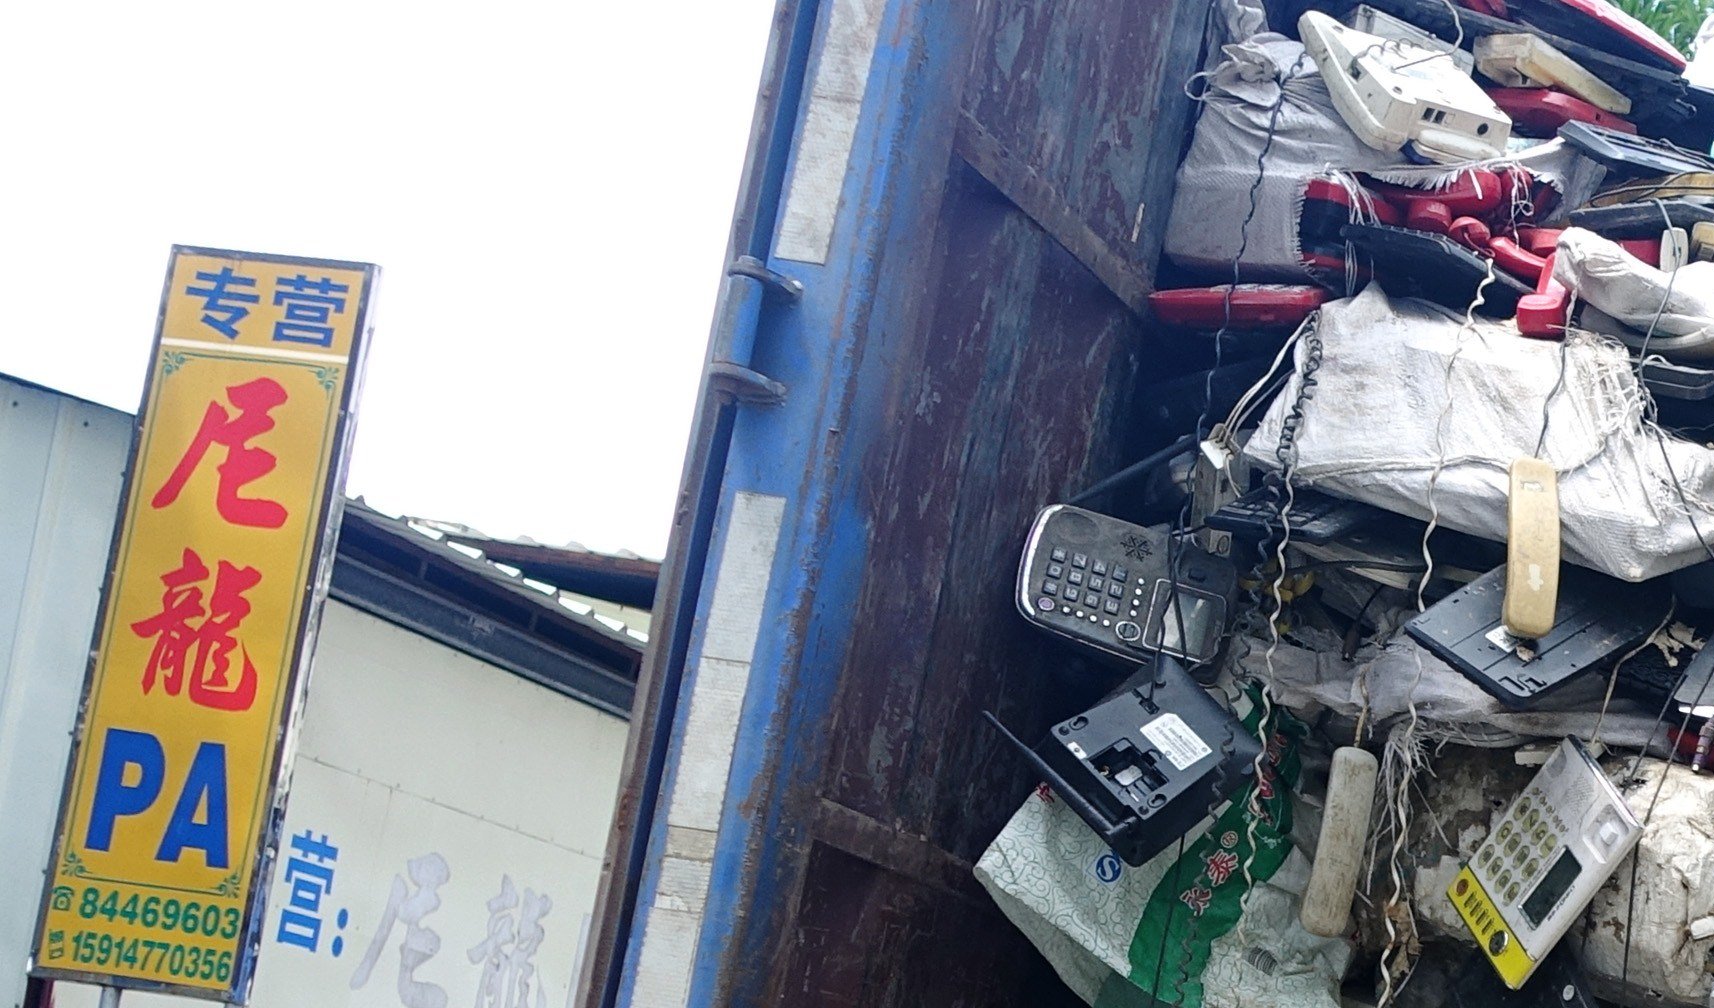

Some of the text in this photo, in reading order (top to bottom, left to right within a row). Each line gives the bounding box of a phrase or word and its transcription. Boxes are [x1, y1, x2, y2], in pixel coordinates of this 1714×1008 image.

[185, 266, 349, 347] 专营
[84, 730, 230, 868] PA
[78, 888, 240, 941] 84469603
[71, 930, 232, 983] 15914770356
